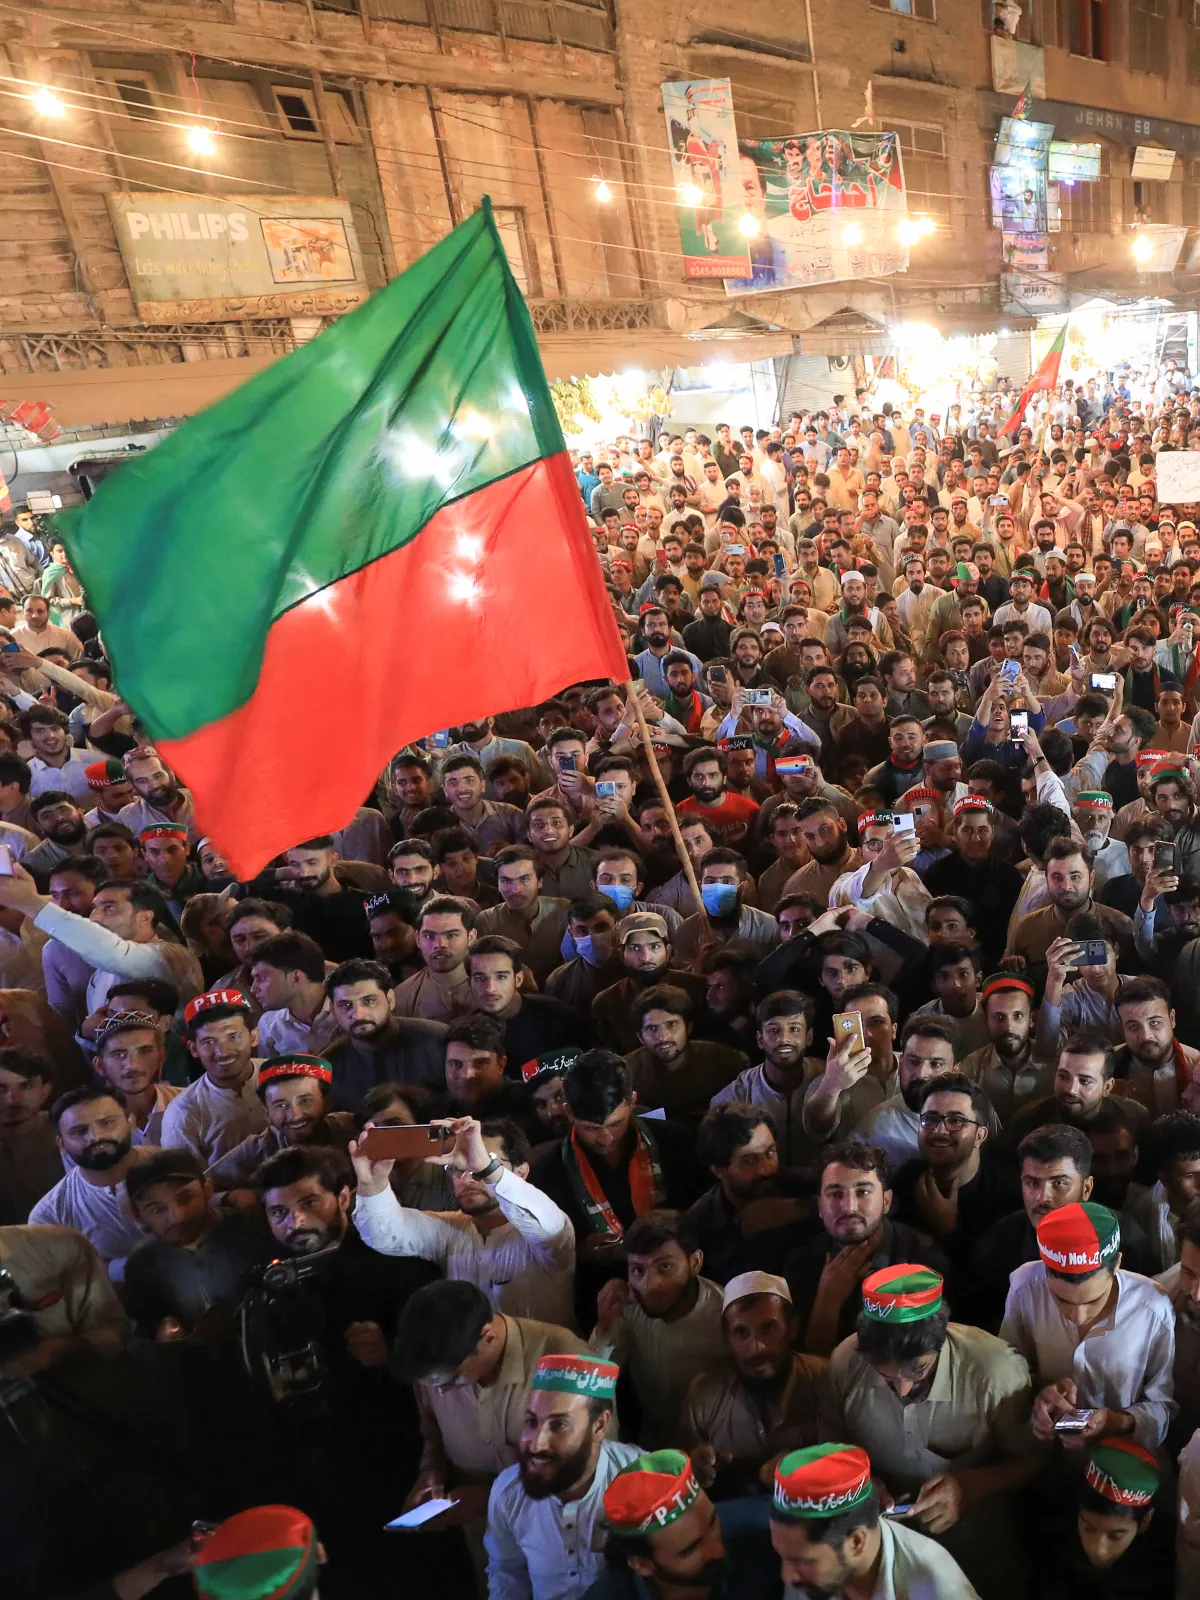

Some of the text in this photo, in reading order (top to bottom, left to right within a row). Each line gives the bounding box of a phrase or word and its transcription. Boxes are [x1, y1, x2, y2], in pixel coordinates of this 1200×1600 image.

[788, 173, 878, 222] احتجاج
[126, 211, 249, 241] PHILIPS
[963, 797, 973, 805] Not
[866, 813, 875, 822] Not
[194, 991, 228, 1012] P.T.I
[1068, 1252, 1087, 1265] Not
[1087, 1459, 1108, 1494] PTI
